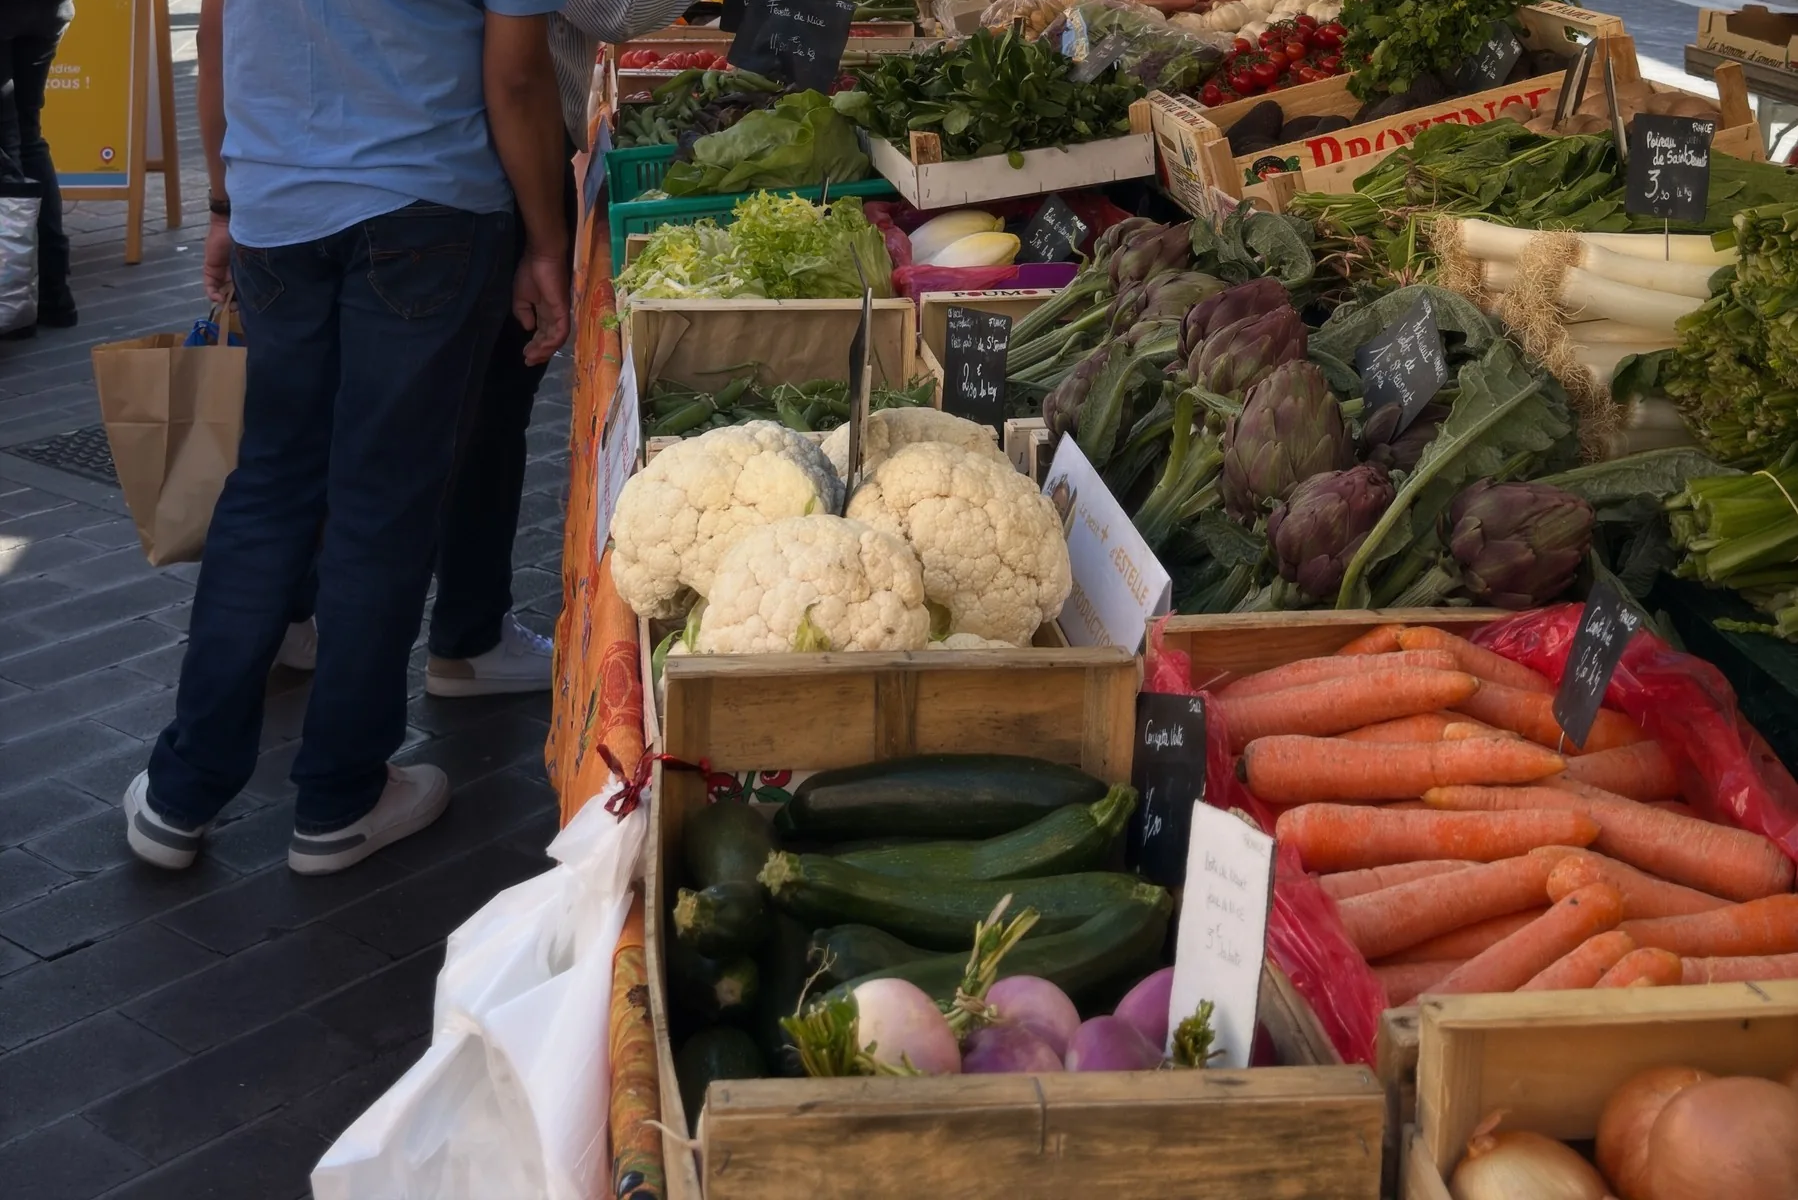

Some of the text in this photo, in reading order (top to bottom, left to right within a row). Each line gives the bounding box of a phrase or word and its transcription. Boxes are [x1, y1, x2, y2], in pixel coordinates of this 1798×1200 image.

[794, 11, 804, 22] de
[807, 14, 826, 27] Nice
[1652, 145, 1665, 166] de
